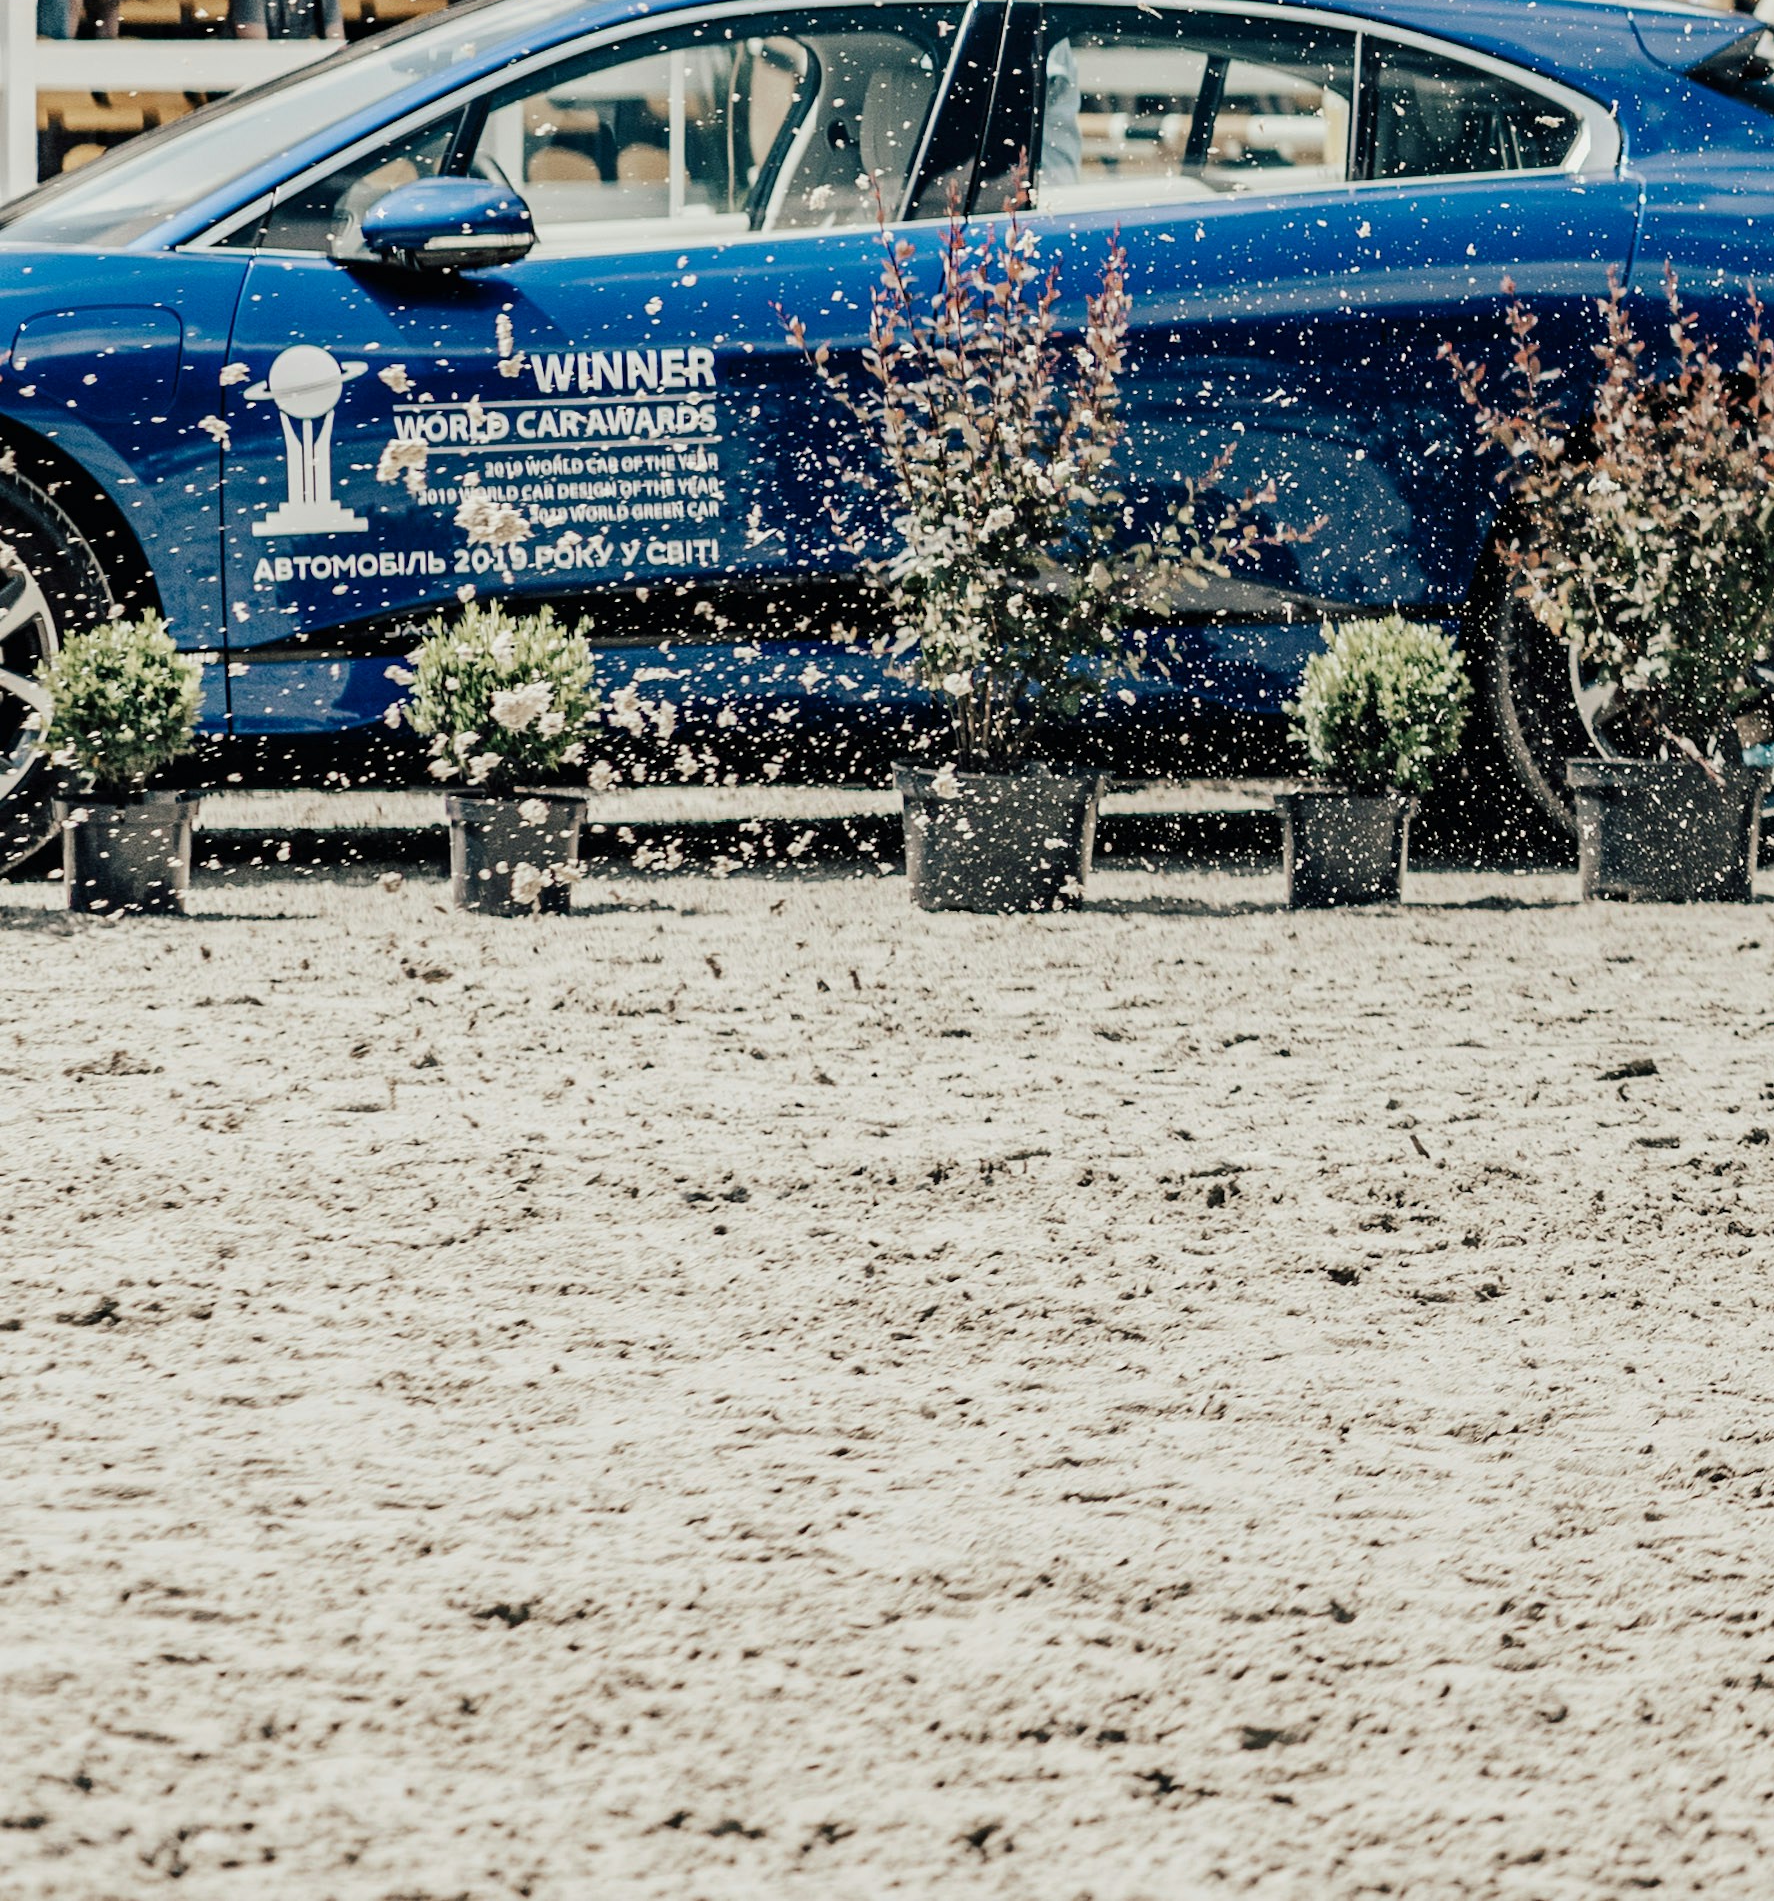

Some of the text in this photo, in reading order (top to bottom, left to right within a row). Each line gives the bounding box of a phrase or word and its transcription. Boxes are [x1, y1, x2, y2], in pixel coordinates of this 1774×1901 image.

[531, 347, 716, 392] WINNER
[394, 403, 717, 442] WORLD CAR AWARDS
[485, 460, 523, 478] 2019
[525, 456, 584, 477] WORLD
[586, 455, 619, 475] CAR
[621, 454, 642, 472] OF
[643, 453, 675, 472] THE
[417, 487, 457, 506] 2019
[521, 483, 554, 502] CAR
[557, 481, 616, 500] DESIGN
[620, 479, 641, 498] OF
[643, 478, 675, 497] THE
[678, 476, 719, 496] YEAR
[568, 503, 629, 523] WORLD
[632, 501, 684, 520] GREEN
[687, 500, 719, 518] CAR
[253, 538, 719, 582] АВТОМОБІЛЬ 2019 РОКУ У СВІТІ
